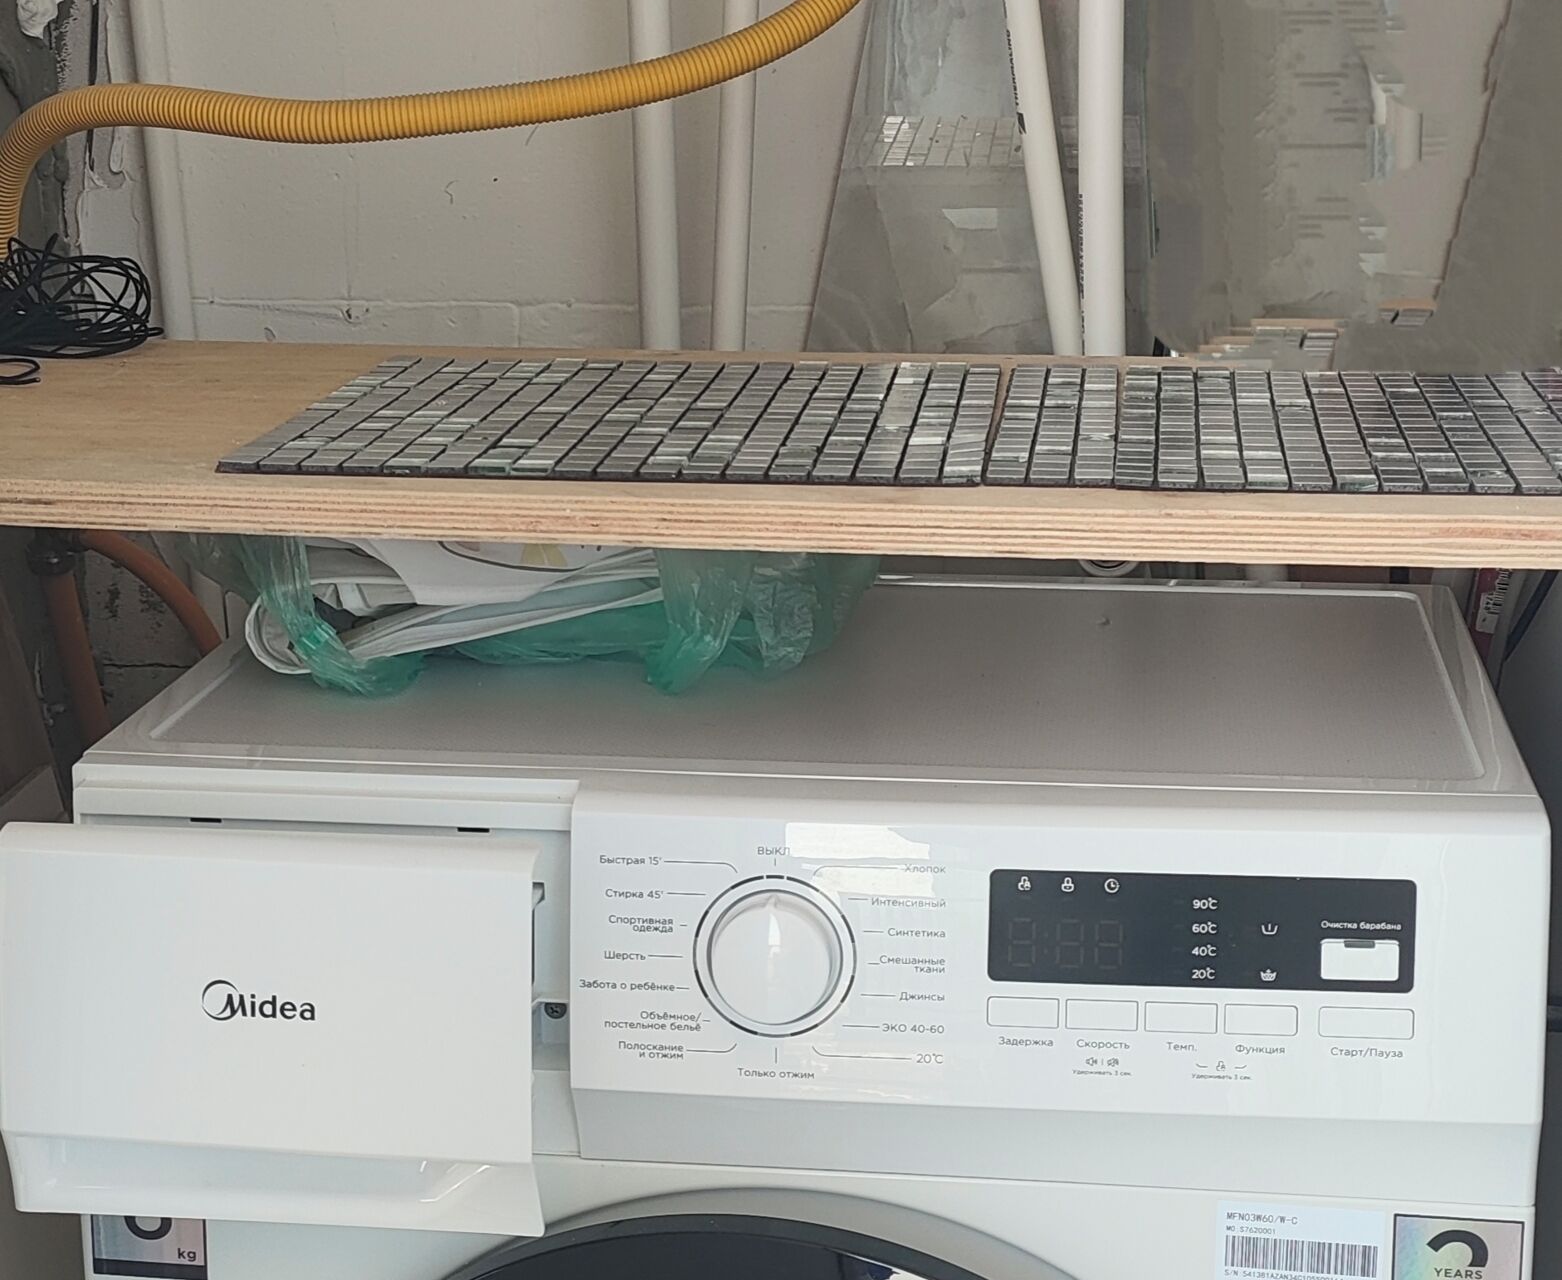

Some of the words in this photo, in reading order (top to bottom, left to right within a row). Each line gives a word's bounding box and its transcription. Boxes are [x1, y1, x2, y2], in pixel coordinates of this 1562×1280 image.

[600, 854, 646, 866] Быстрая
[903, 863, 947, 874] Хлопок
[605, 889, 644, 899] Стирка
[871, 896, 947, 908] Интенсивный
[608, 914, 674, 926] Спортивная
[1321, 920, 1358, 929] Очистка
[1359, 921, 1402, 931] барабана
[632, 923, 674, 933] одежда
[887, 927, 946, 938] Синтетика
[603, 950, 646, 961] Шерсть
[879, 954, 946, 966] Смешанные
[914, 965, 946, 974] ткани
[579, 979, 617, 989] Забота
[620, 982, 627, 990] о
[630, 981, 676, 991] ребёнке
[201, 979, 316, 1021] Midea
[899, 991, 945, 1001] Джинсы
[640, 1010, 702, 1023] Объёмное/
[604, 1020, 667, 1030] постельное
[669, 1022, 702, 1032] бельё
[881, 1023, 907, 1033] ЭКО
[910, 1024, 945, 1034] 40-60
[618, 1040, 684, 1052] Полоскание
[998, 1036, 1054, 1048] Задержка
[1076, 1039, 1130, 1051] Скорость
[1166, 1041, 1197, 1052] Темп.
[648, 1051, 684, 1060] отжим
[1234, 1044, 1286, 1055] Функция
[1330, 1046, 1404, 1059] Старт/Пауза
[737, 1067, 776, 1078] Только
[779, 1071, 815, 1079] отжим
[177, 1247, 197, 1262] kg
[1433, 1267, 1483, 1280] YEARS
